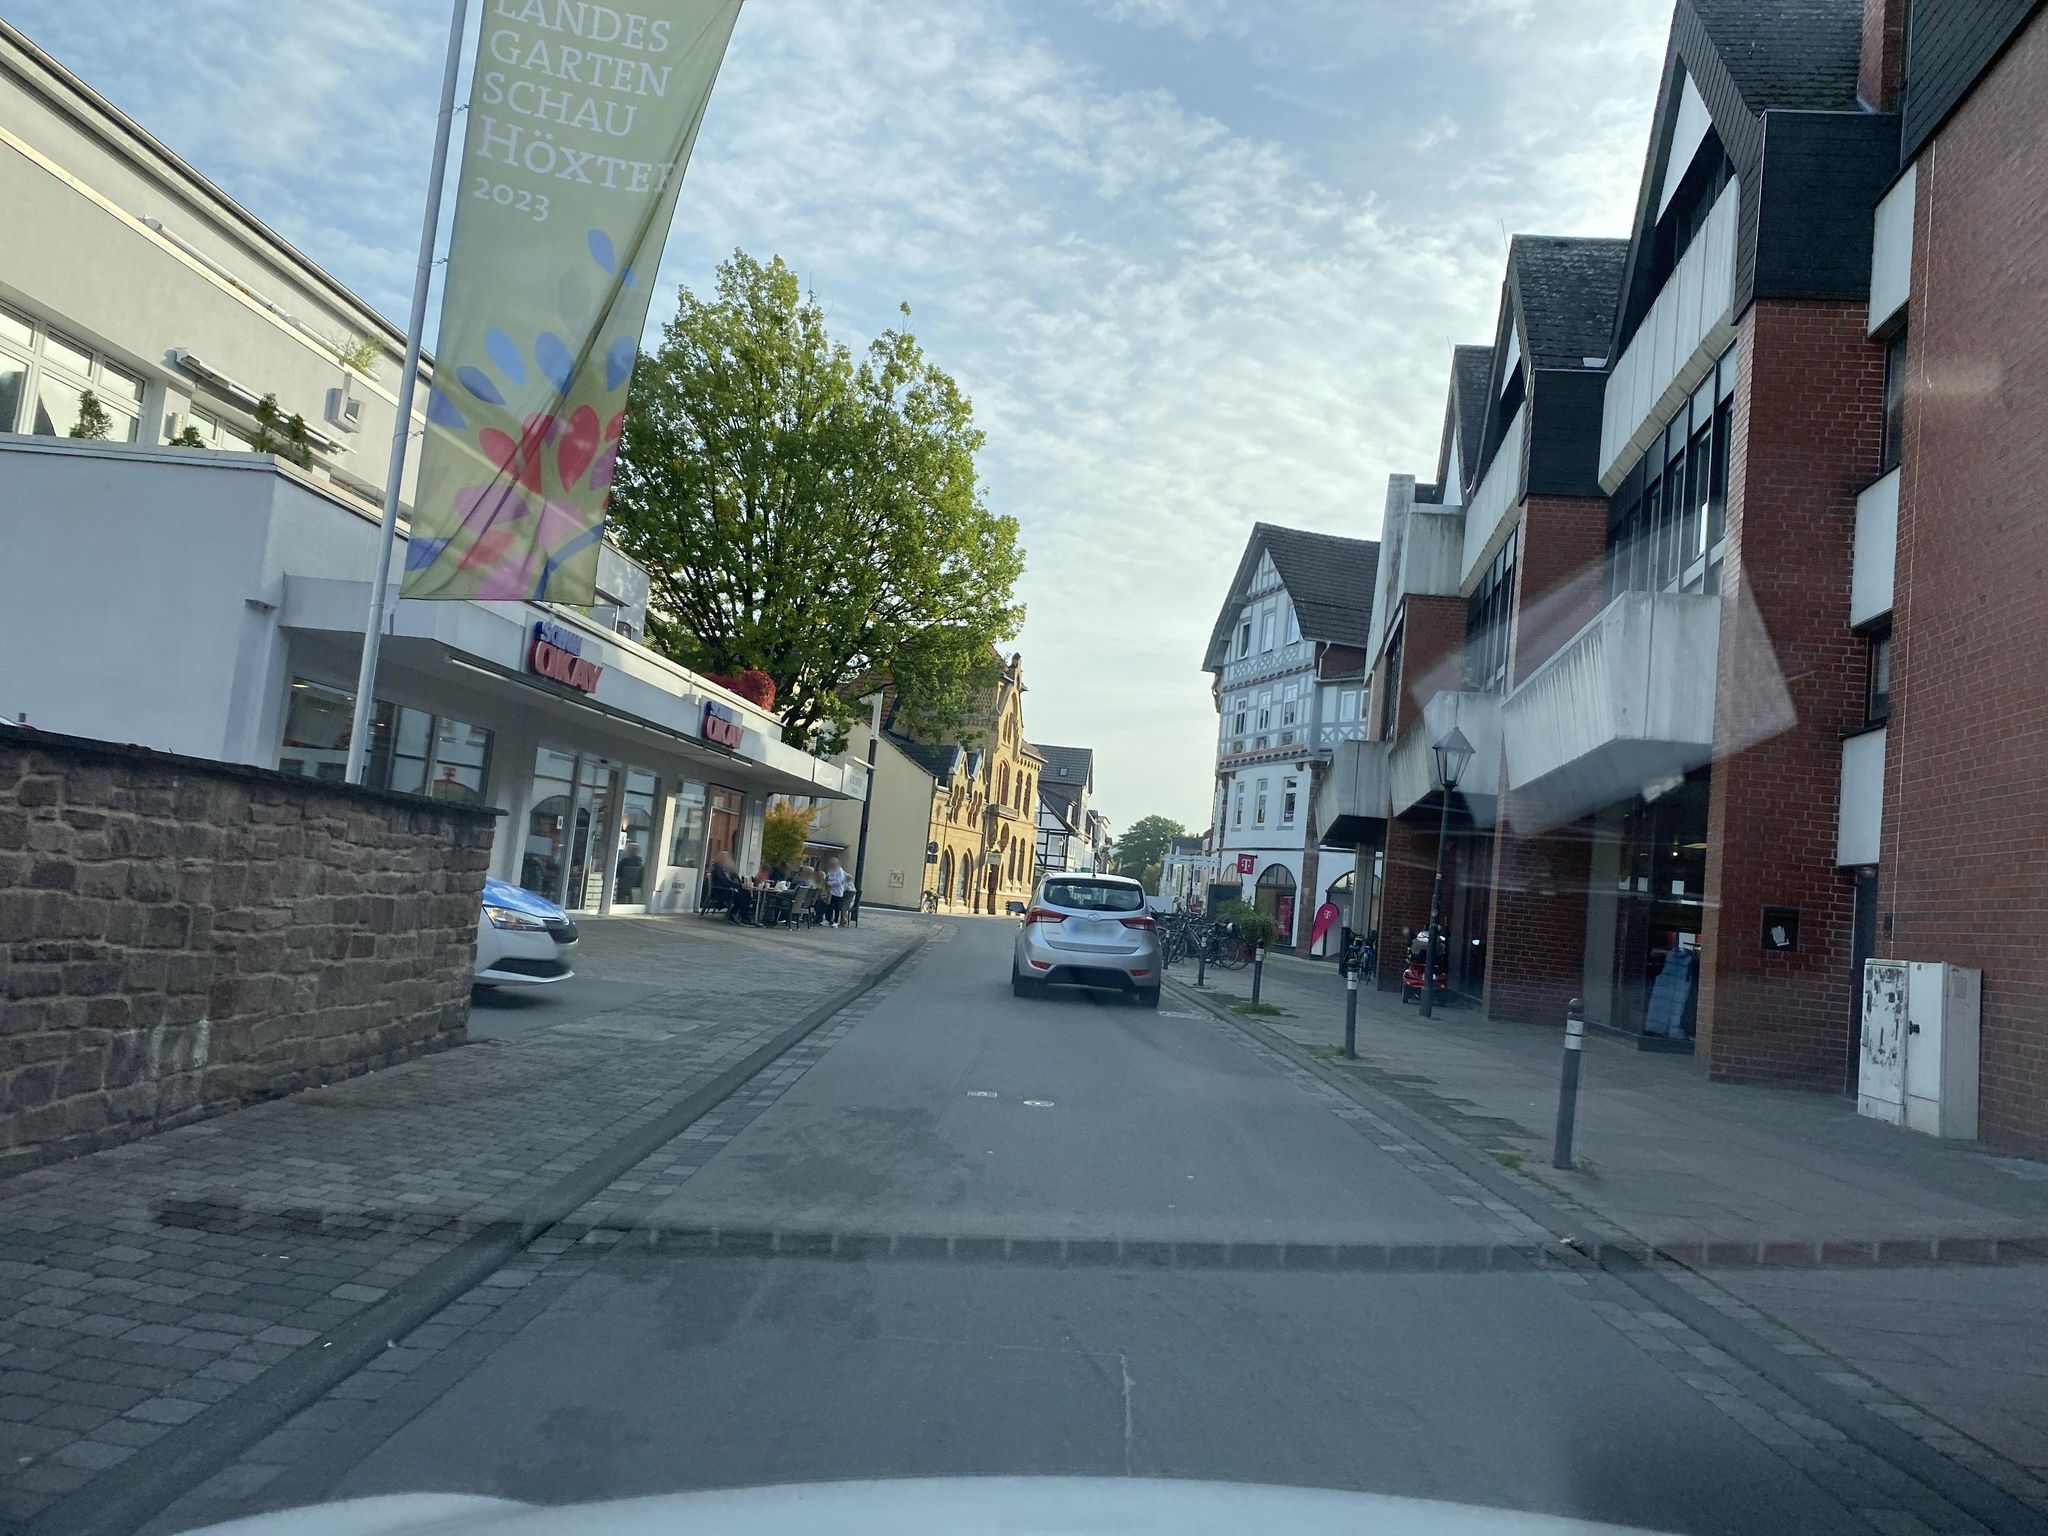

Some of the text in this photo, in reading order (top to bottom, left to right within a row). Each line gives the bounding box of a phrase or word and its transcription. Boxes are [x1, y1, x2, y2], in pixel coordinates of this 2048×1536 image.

[495, 0, 671, 52] LANDES
[490, 29, 672, 97] GARTEN
[482, 72, 638, 137] SCHAU
[473, 176, 550, 221] 2023
[532, 641, 603, 693] OKAY
